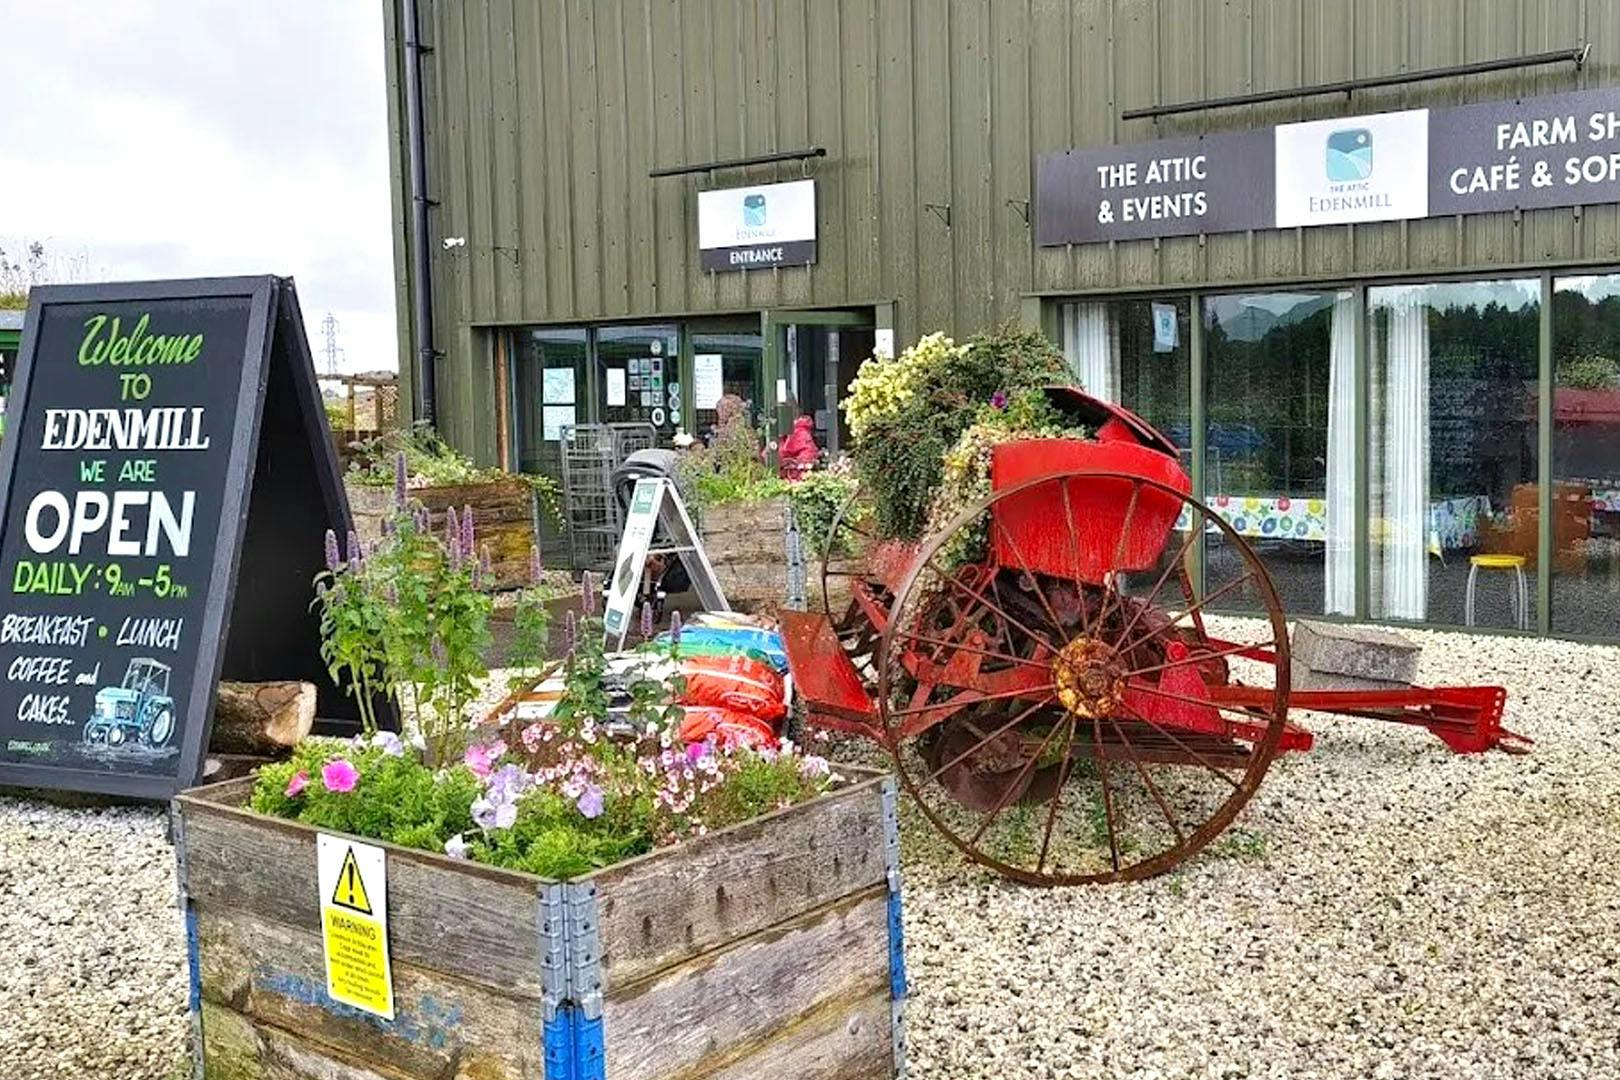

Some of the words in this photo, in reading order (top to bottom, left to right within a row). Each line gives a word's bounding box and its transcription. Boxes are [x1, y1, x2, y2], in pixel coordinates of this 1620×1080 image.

[1496, 116, 1577, 150] FARM
[1097, 163, 1137, 189] THE
[1145, 155, 1207, 184] ATTIC
[1450, 156, 1520, 194] CAFÉ
[1531, 160, 1553, 188] &
[1097, 200, 1114, 224] &
[1122, 191, 1208, 222] EVENTS
[1310, 193, 1392, 212] EDENMILL
[729, 247, 783, 264] ENTRANCE
[78, 313, 204, 367] Welcome
[119, 373, 152, 400] TO
[41, 407, 210, 450] EDENMILL
[80, 460, 107, 482] WE
[118, 460, 157, 483] ARE
[24, 490, 196, 557] OPEN
[0, 613, 95, 646] BREAKFAST
[116, 617, 183, 650] LUNCH
[7, 656, 72, 684] COFFEE
[75, 661, 100, 685] and
[330, 913, 377, 941] WARNING
